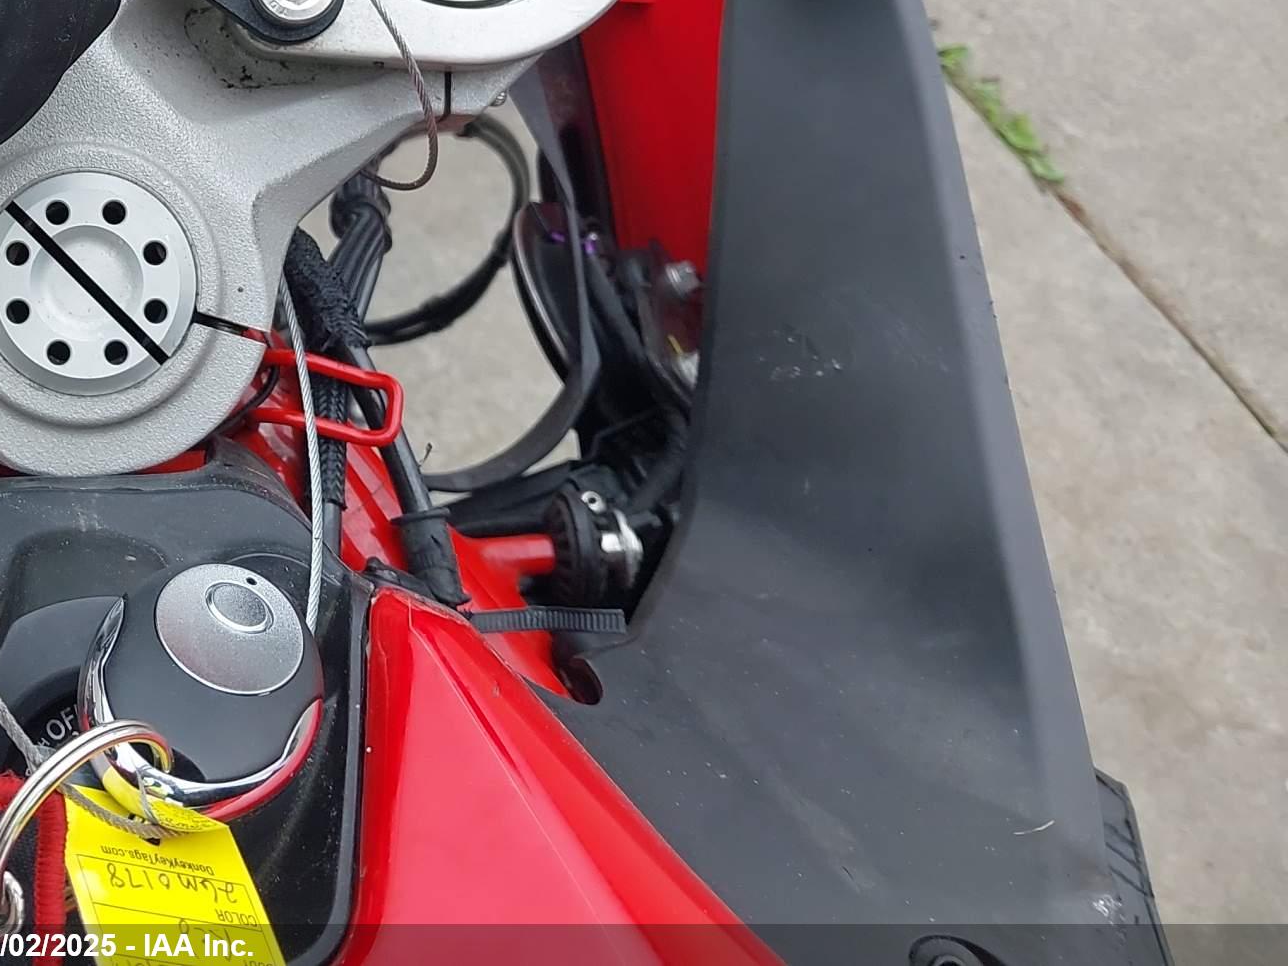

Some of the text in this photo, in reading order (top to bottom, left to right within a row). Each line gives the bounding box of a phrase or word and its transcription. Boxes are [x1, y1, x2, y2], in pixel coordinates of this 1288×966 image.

[45, 703, 78, 741] OF
[100, 845, 215, 876] DonkeyKeyTags.com
[215, 908, 258, 928] COLOR
